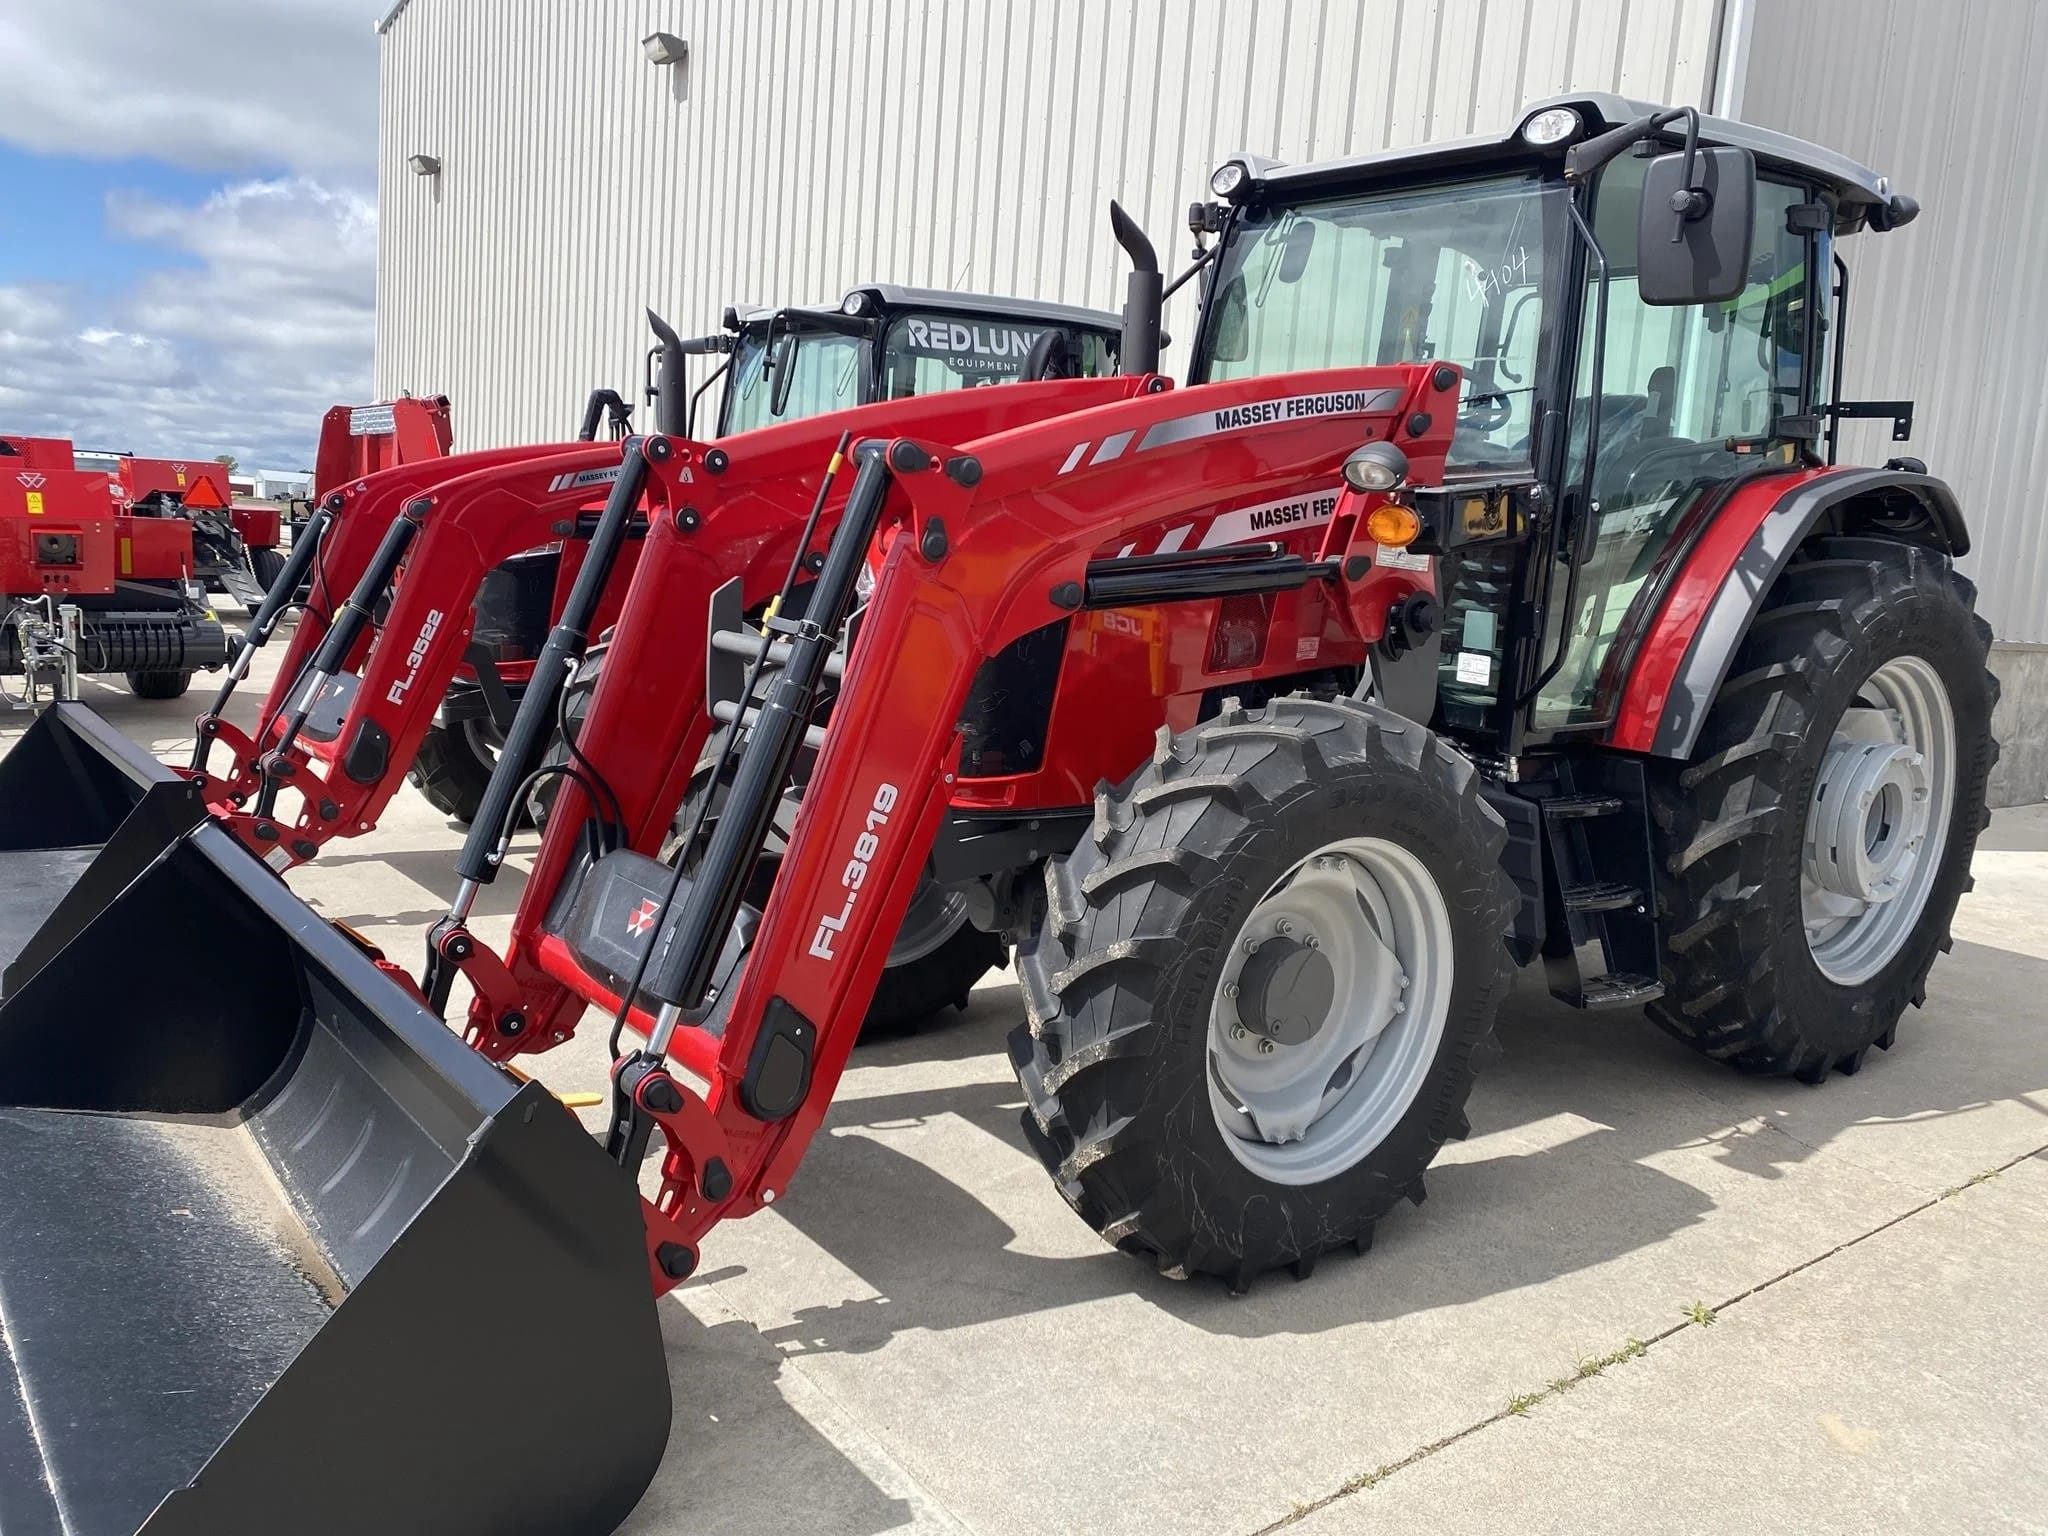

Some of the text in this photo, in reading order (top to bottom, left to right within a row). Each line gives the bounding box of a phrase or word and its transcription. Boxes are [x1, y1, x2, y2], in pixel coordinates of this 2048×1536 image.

[949, 357, 1018, 371] EQUIPMENT
[1215, 392, 1366, 431] MASSEY FERGUSON
[578, 471, 608, 483] MASSEY
[1249, 496, 1340, 531] MASSEY FER
[386, 609, 444, 705] FL.3522
[808, 782, 899, 961] FL.3819
